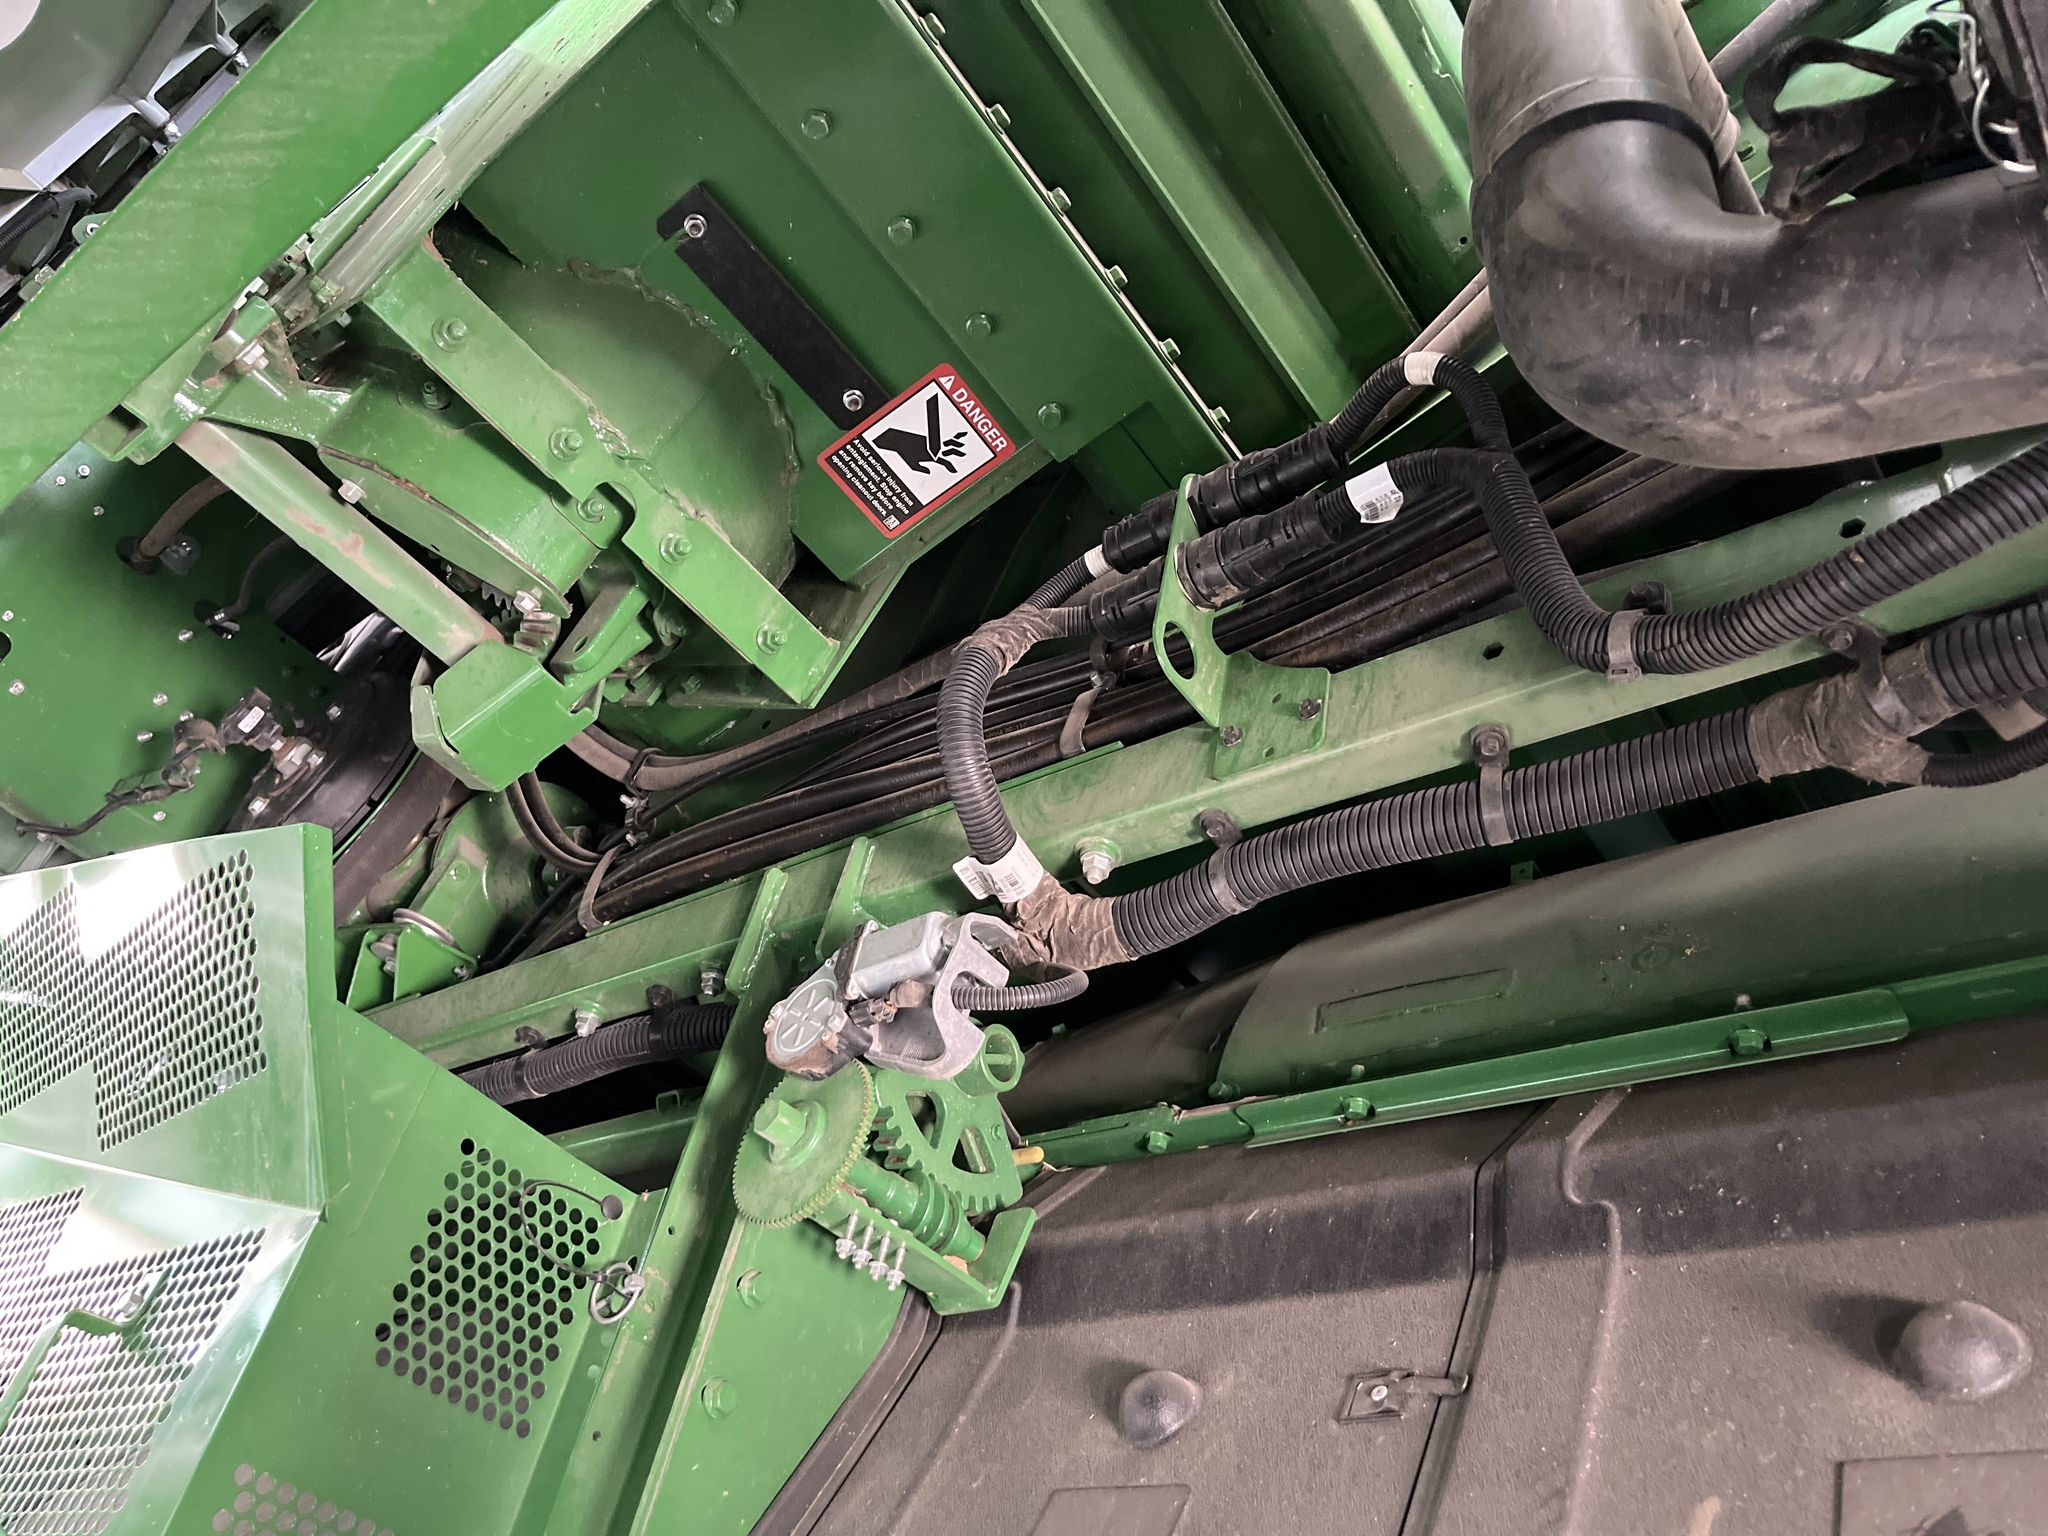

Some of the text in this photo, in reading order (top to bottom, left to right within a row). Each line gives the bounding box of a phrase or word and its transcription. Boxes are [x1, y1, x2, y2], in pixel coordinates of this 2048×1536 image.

[951, 387, 1007, 452] DANGER
[831, 455, 853, 479] opening
[850, 476, 874, 501] cleanout
[871, 499, 887, 517] doors.
[838, 449, 851, 462] and
[848, 460, 868, 482] remove
[866, 480, 878, 492] key
[876, 490, 893, 510] before
[845, 444, 909, 515] entanglement. Stop engine
[852, 439, 914, 507] Avoid serious injury from
